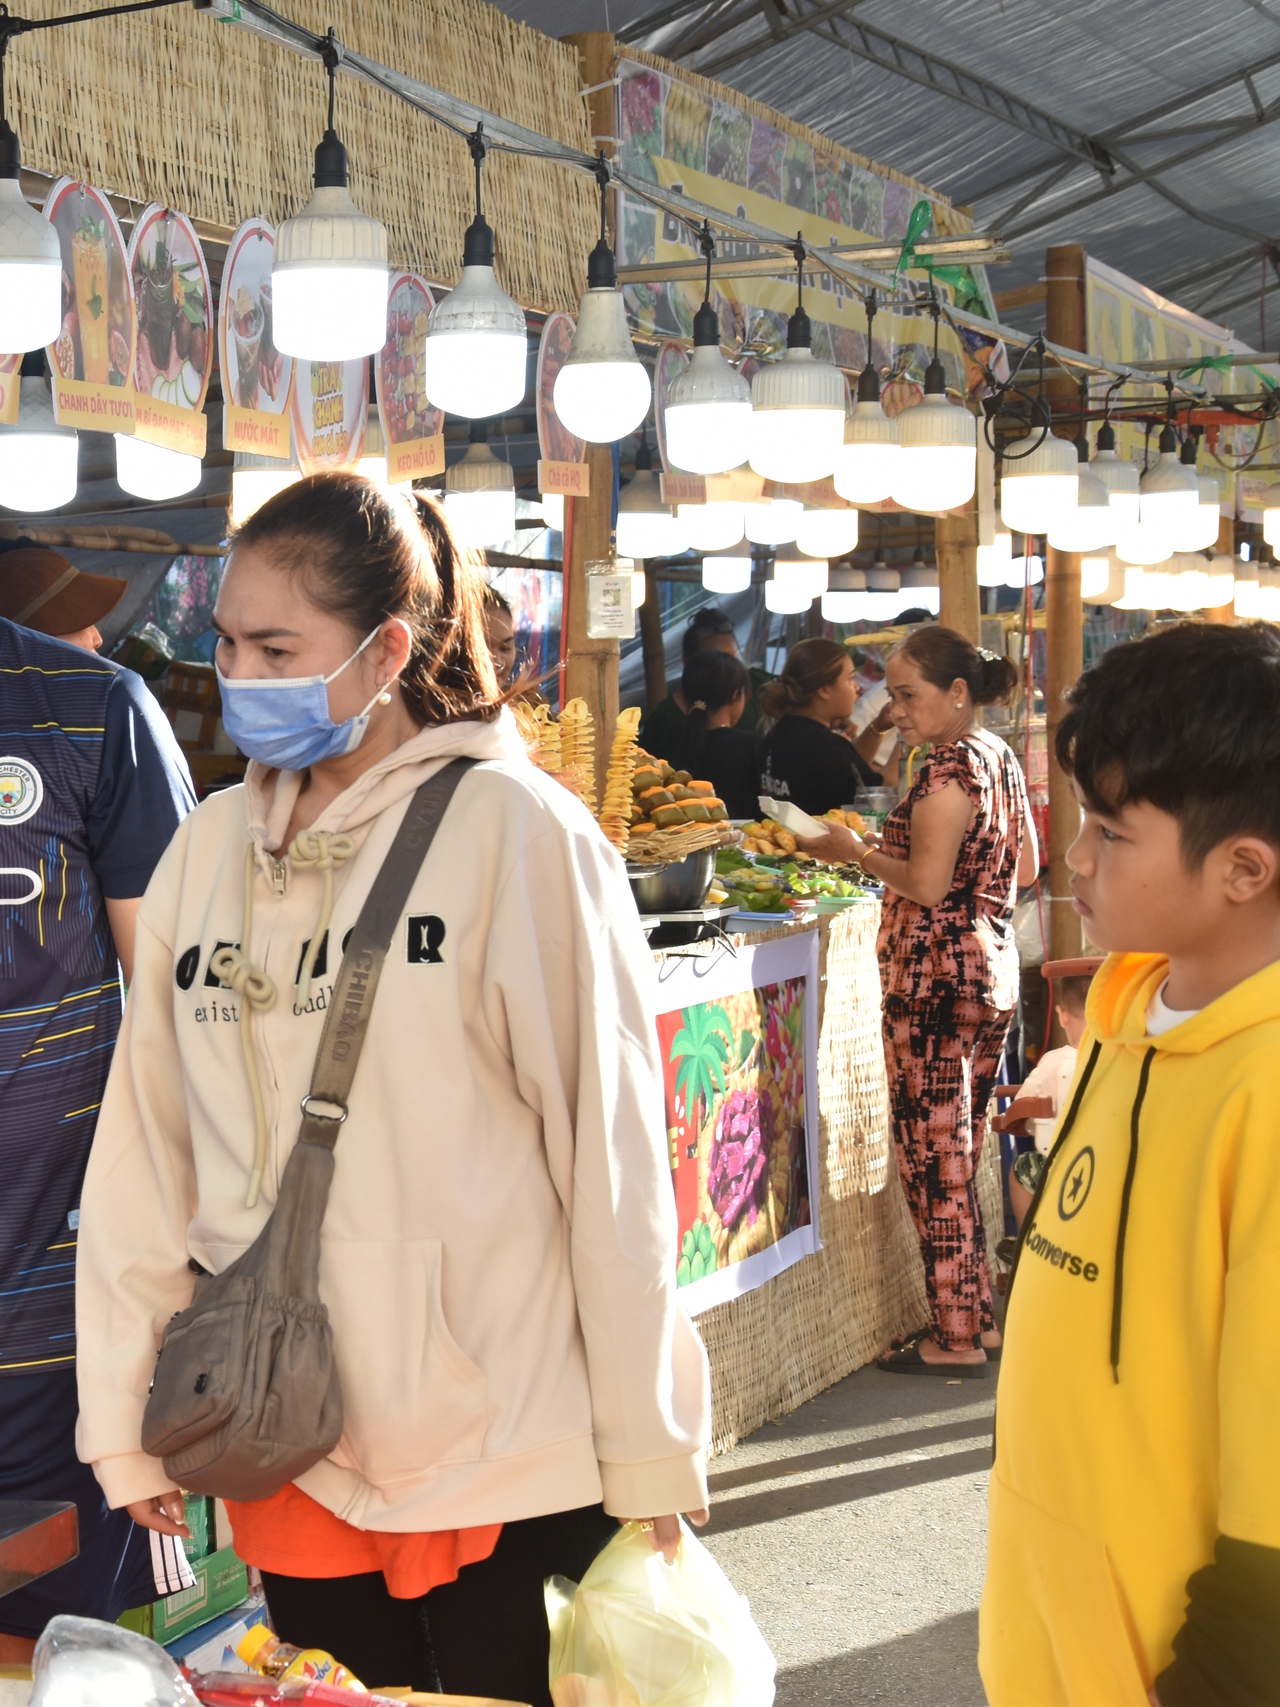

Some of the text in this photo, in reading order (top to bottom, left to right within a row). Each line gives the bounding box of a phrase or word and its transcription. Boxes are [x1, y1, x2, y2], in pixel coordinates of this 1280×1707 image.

[59, 391, 89, 413] CHANH
[90, 392, 108, 415] DÂY
[234, 418, 280, 445] NƯỚC MÁT
[195, 1000, 240, 1023] exist
